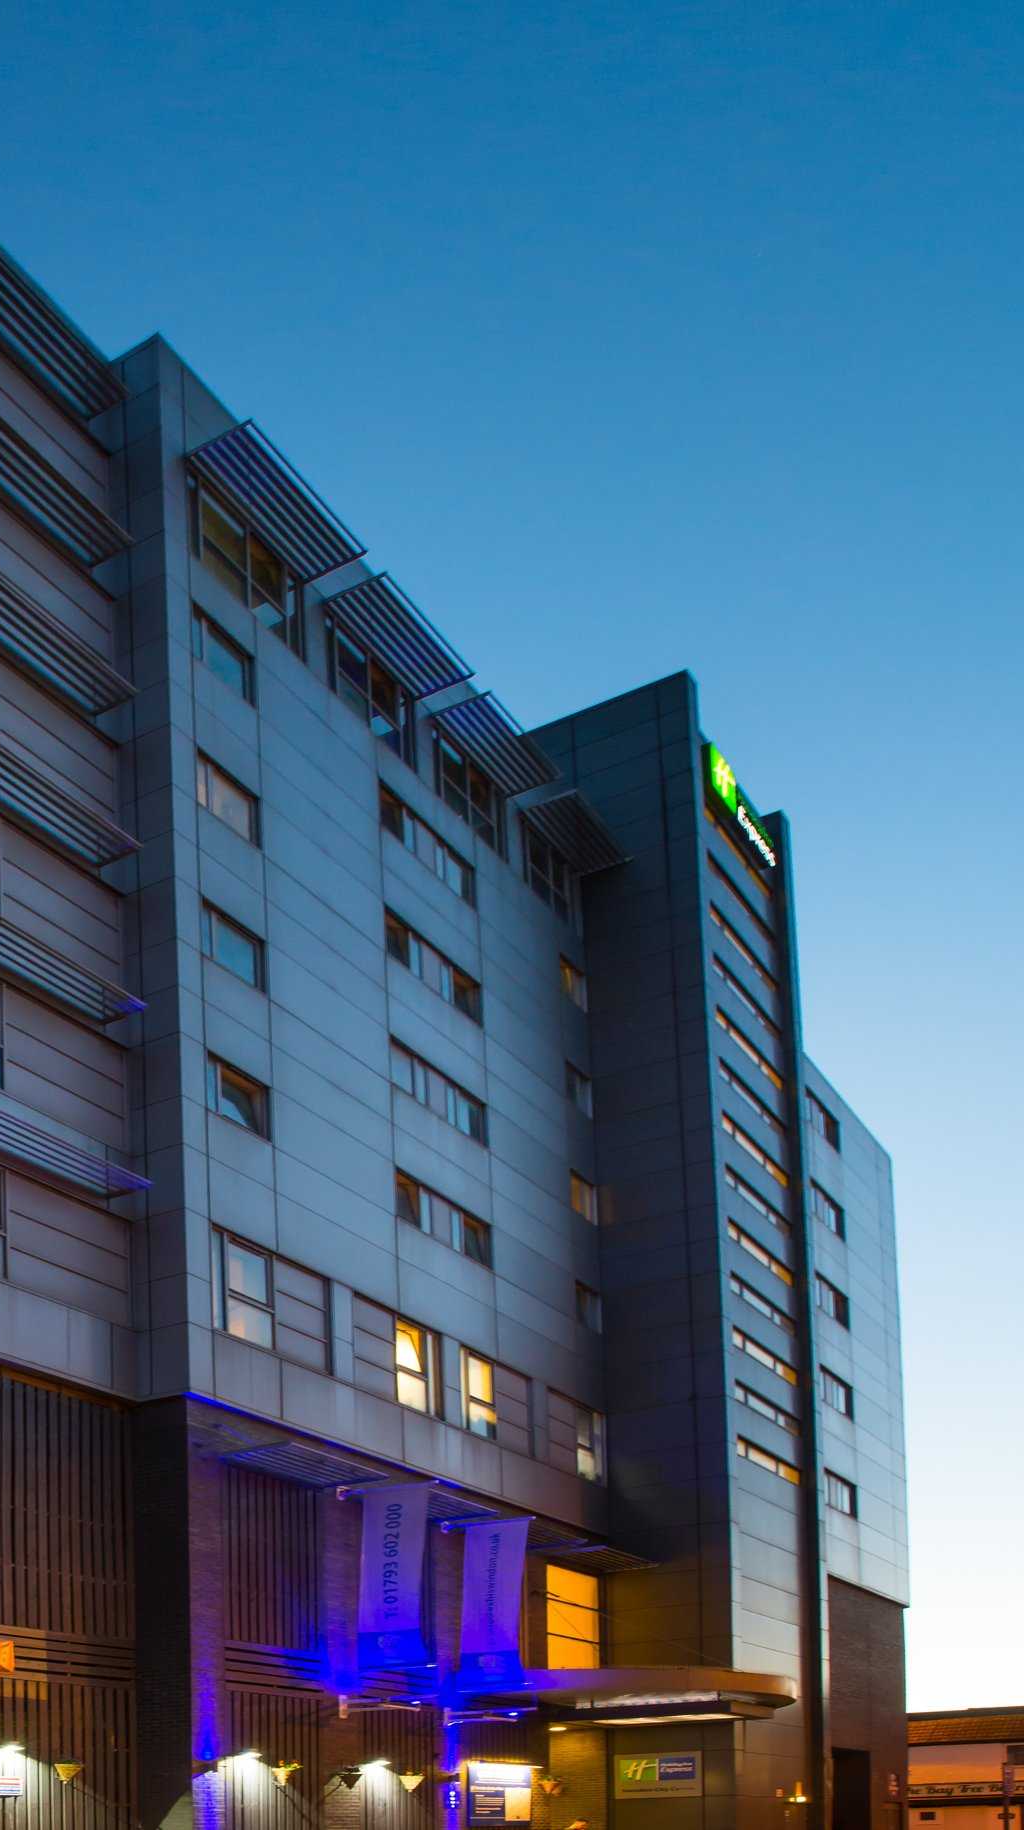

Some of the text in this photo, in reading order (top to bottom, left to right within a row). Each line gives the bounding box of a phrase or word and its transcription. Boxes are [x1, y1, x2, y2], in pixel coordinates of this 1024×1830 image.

[385, 1503, 403, 1529] 000
[383, 1532, 400, 1558] 602
[383, 1561, 399, 1604] 01793
